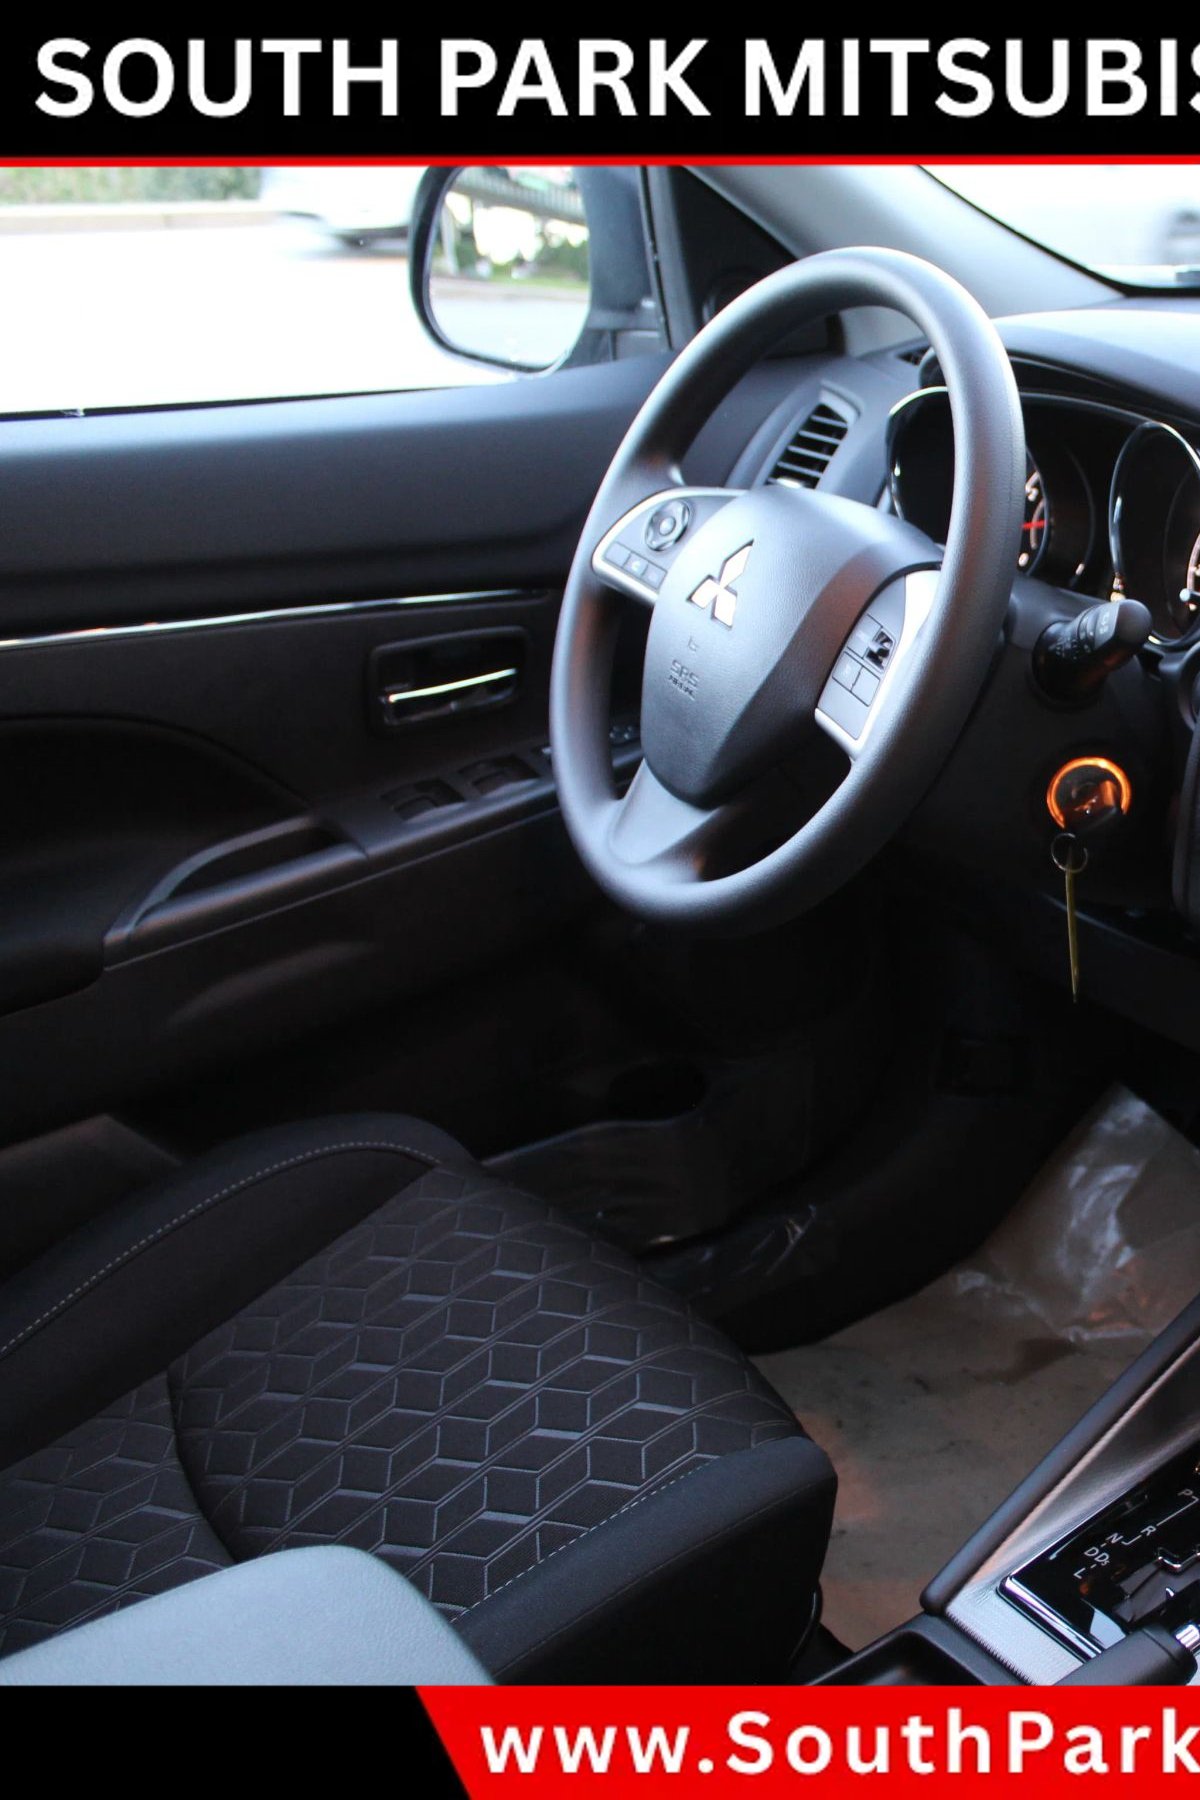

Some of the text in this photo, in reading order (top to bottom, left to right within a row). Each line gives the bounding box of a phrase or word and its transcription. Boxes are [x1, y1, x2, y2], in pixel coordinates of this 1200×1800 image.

[1140, 1525, 1157, 1537] R
[1105, 1532, 1124, 1544] N
[1073, 1567, 1086, 1580] L
